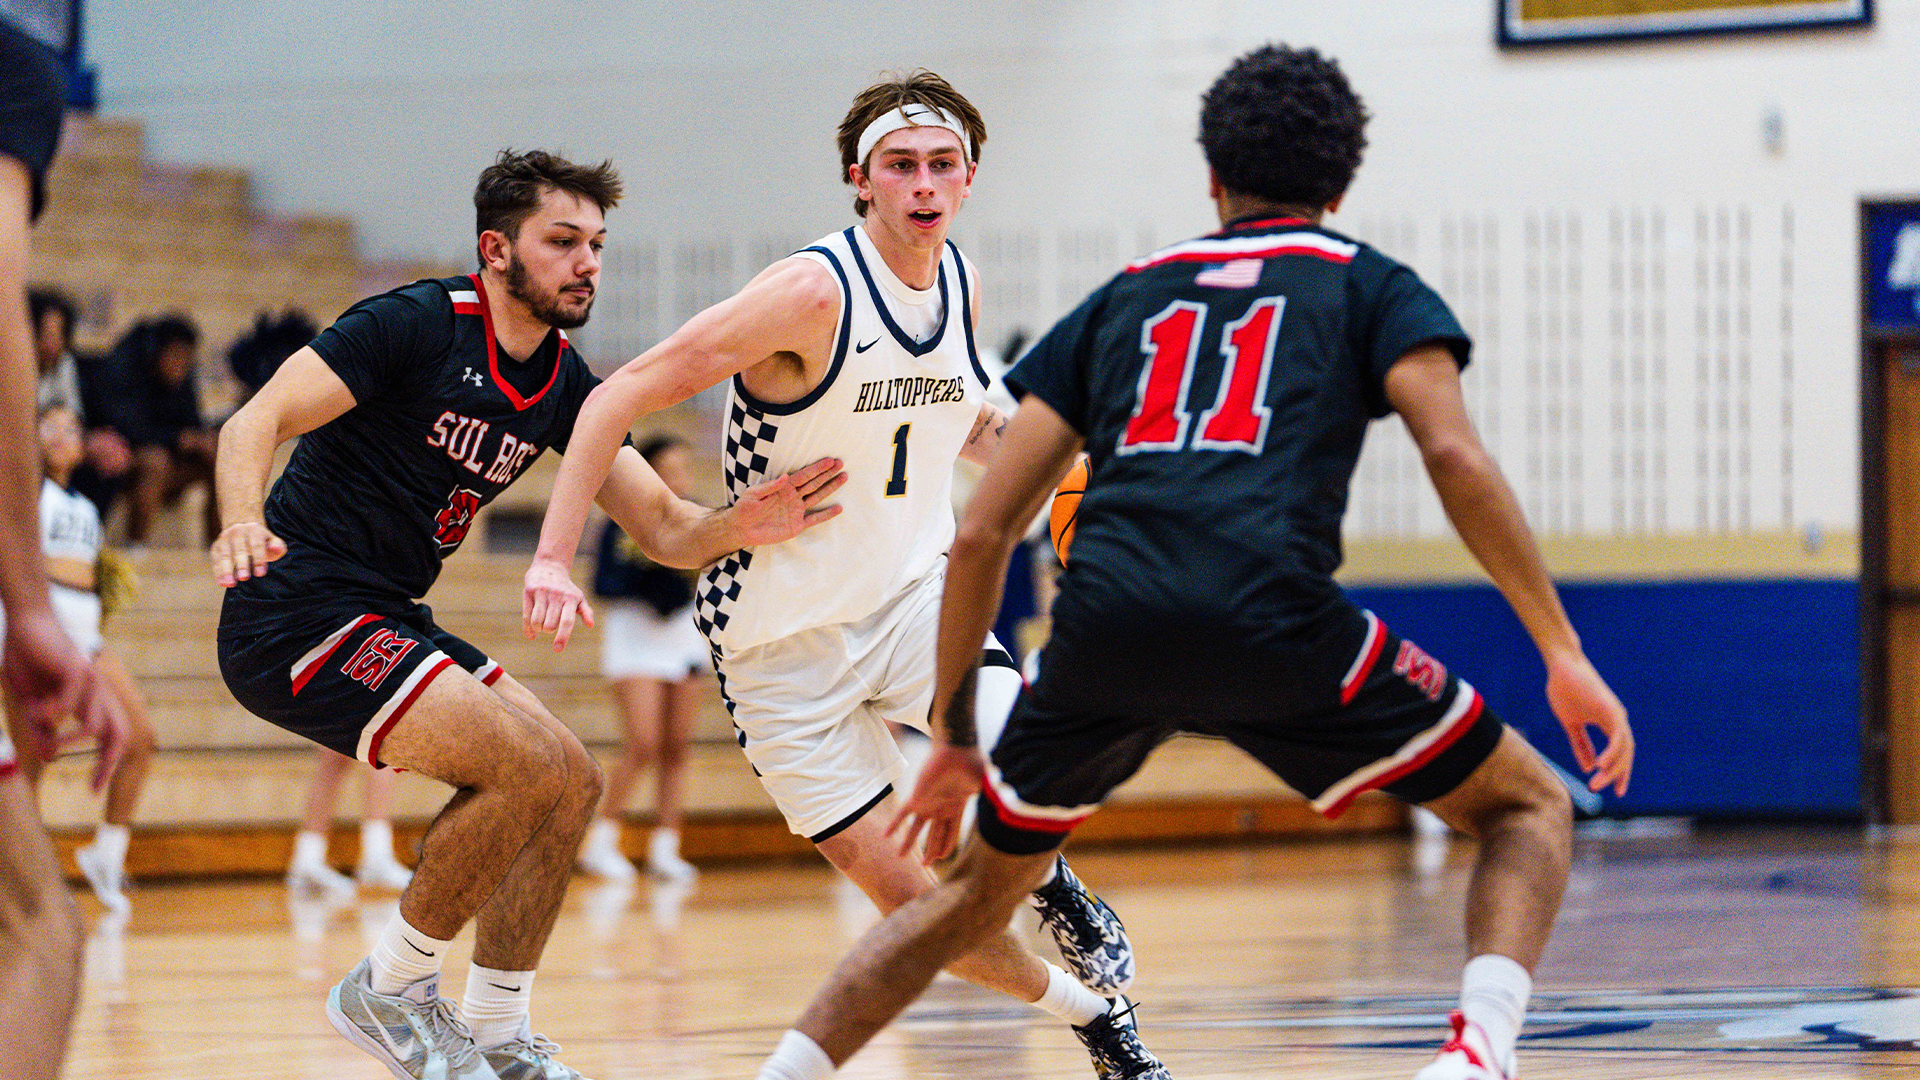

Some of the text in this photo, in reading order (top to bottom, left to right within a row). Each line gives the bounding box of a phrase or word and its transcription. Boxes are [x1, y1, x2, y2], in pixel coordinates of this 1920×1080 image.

[853, 375, 965, 413] HILLTOPPERS
[1114, 295, 1287, 456] 11
[426, 410, 490, 475] SUL
[883, 421, 913, 499] 1
